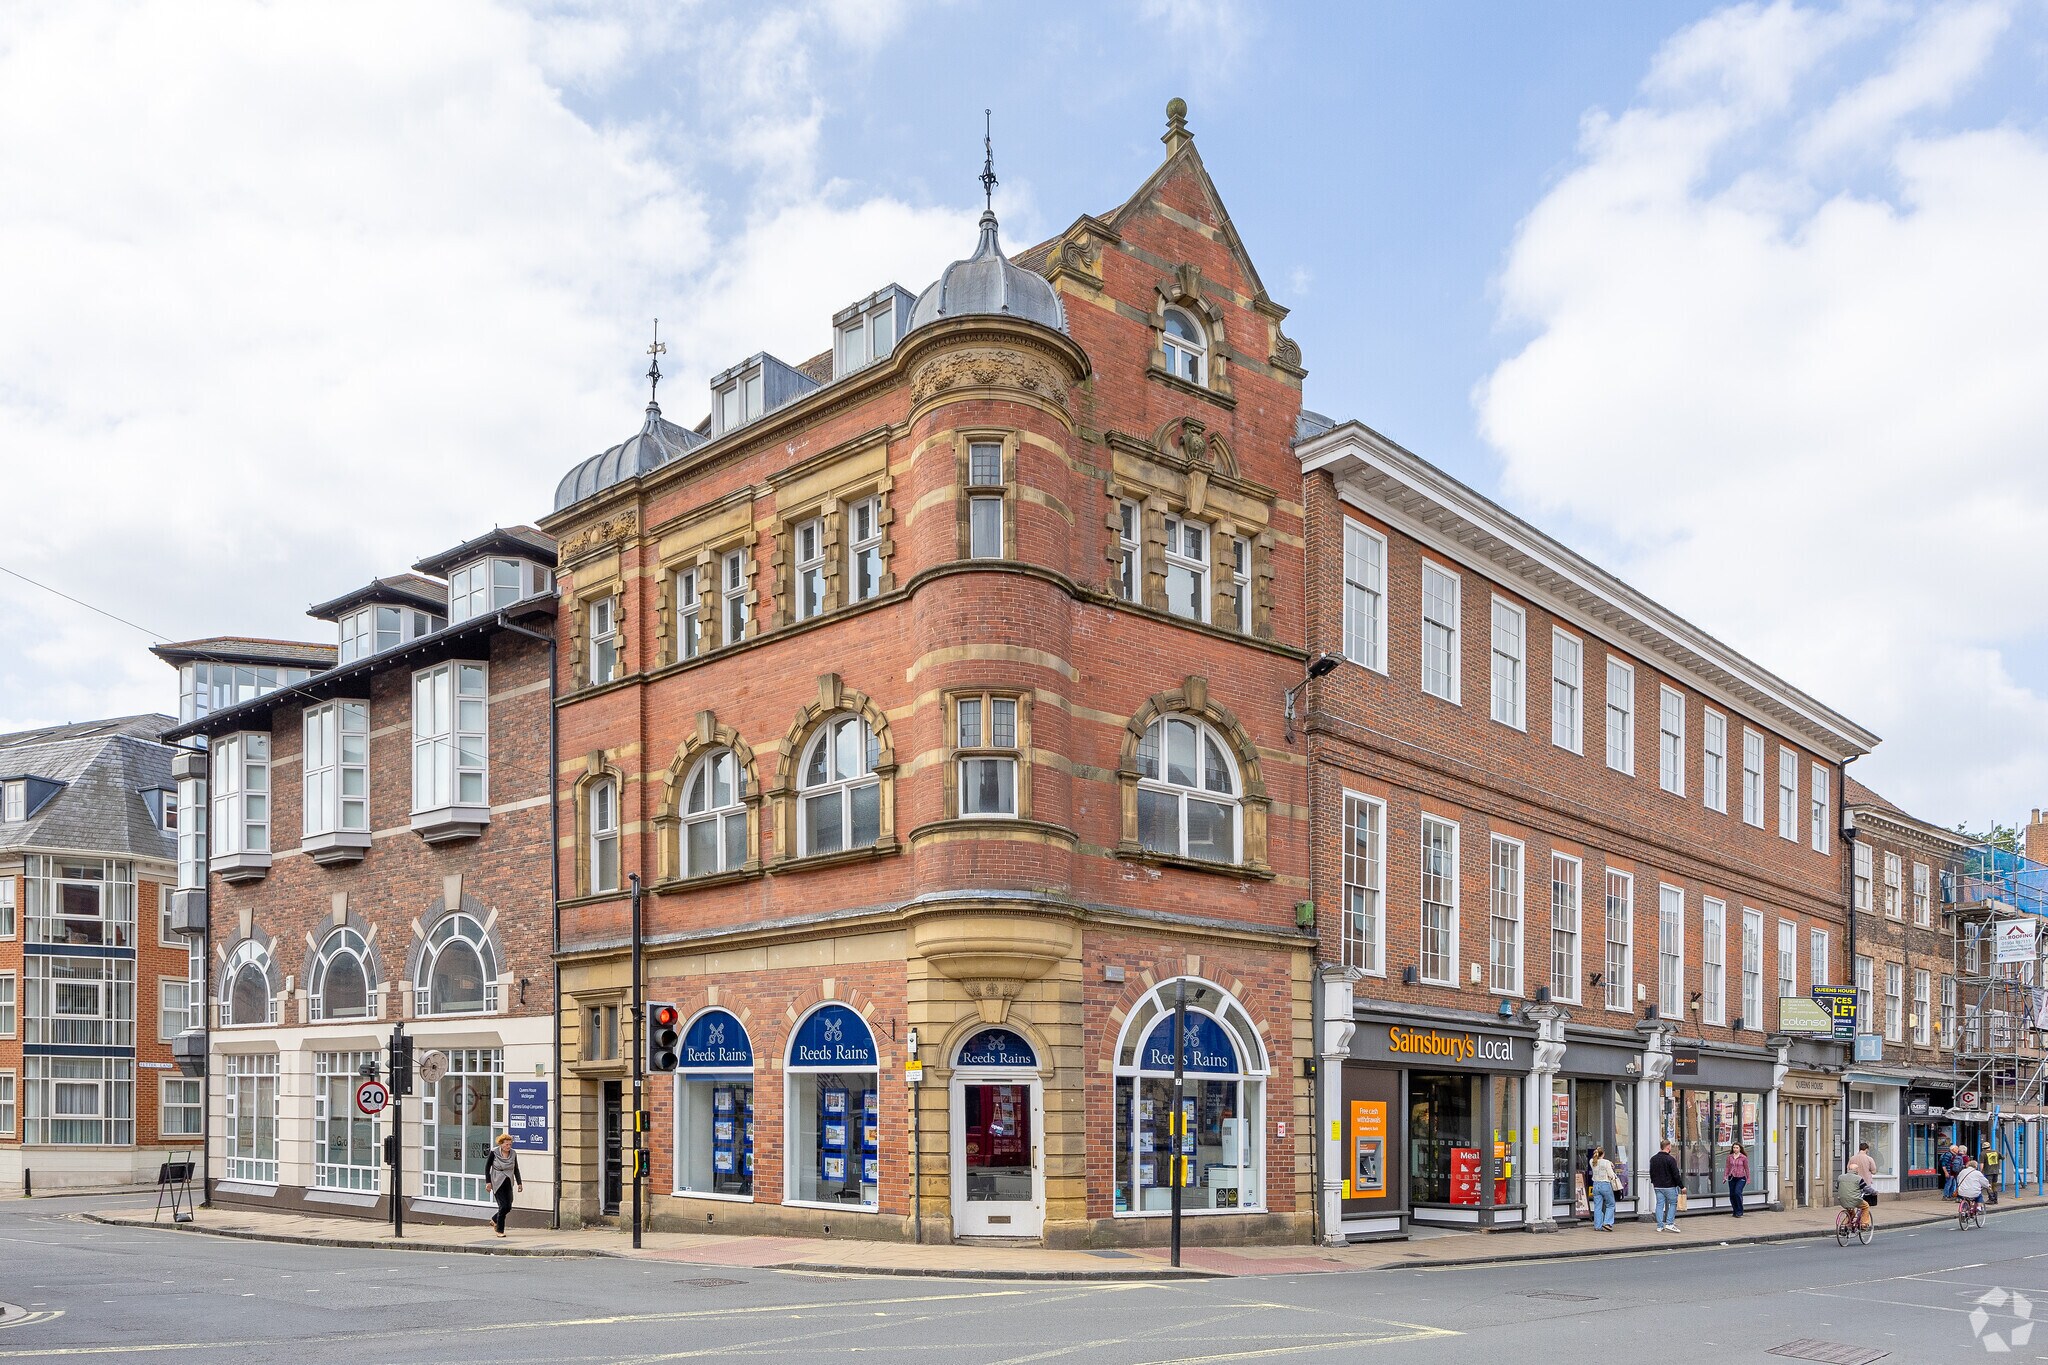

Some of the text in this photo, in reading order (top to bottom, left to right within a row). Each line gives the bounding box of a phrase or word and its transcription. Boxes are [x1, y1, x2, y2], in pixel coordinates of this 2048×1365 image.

[1822, 1003, 1832, 1013] LET
[1834, 1005, 1856, 1017] LET
[1782, 1017, 1827, 1027] colenso
[1388, 1026, 1514, 1062] Sainsbury's Local
[687, 1047, 747, 1062] Reeds Rains
[799, 1044, 869, 1060] Reeds Rains
[963, 1052, 1031, 1064] Reeds Rains
[1150, 1048, 1228, 1067] Rees Rains
[1795, 1080, 1824, 1090] QUEENS HOUSE
[362, 1091, 384, 1104] 20
[1359, 1107, 1369, 1115] Free
